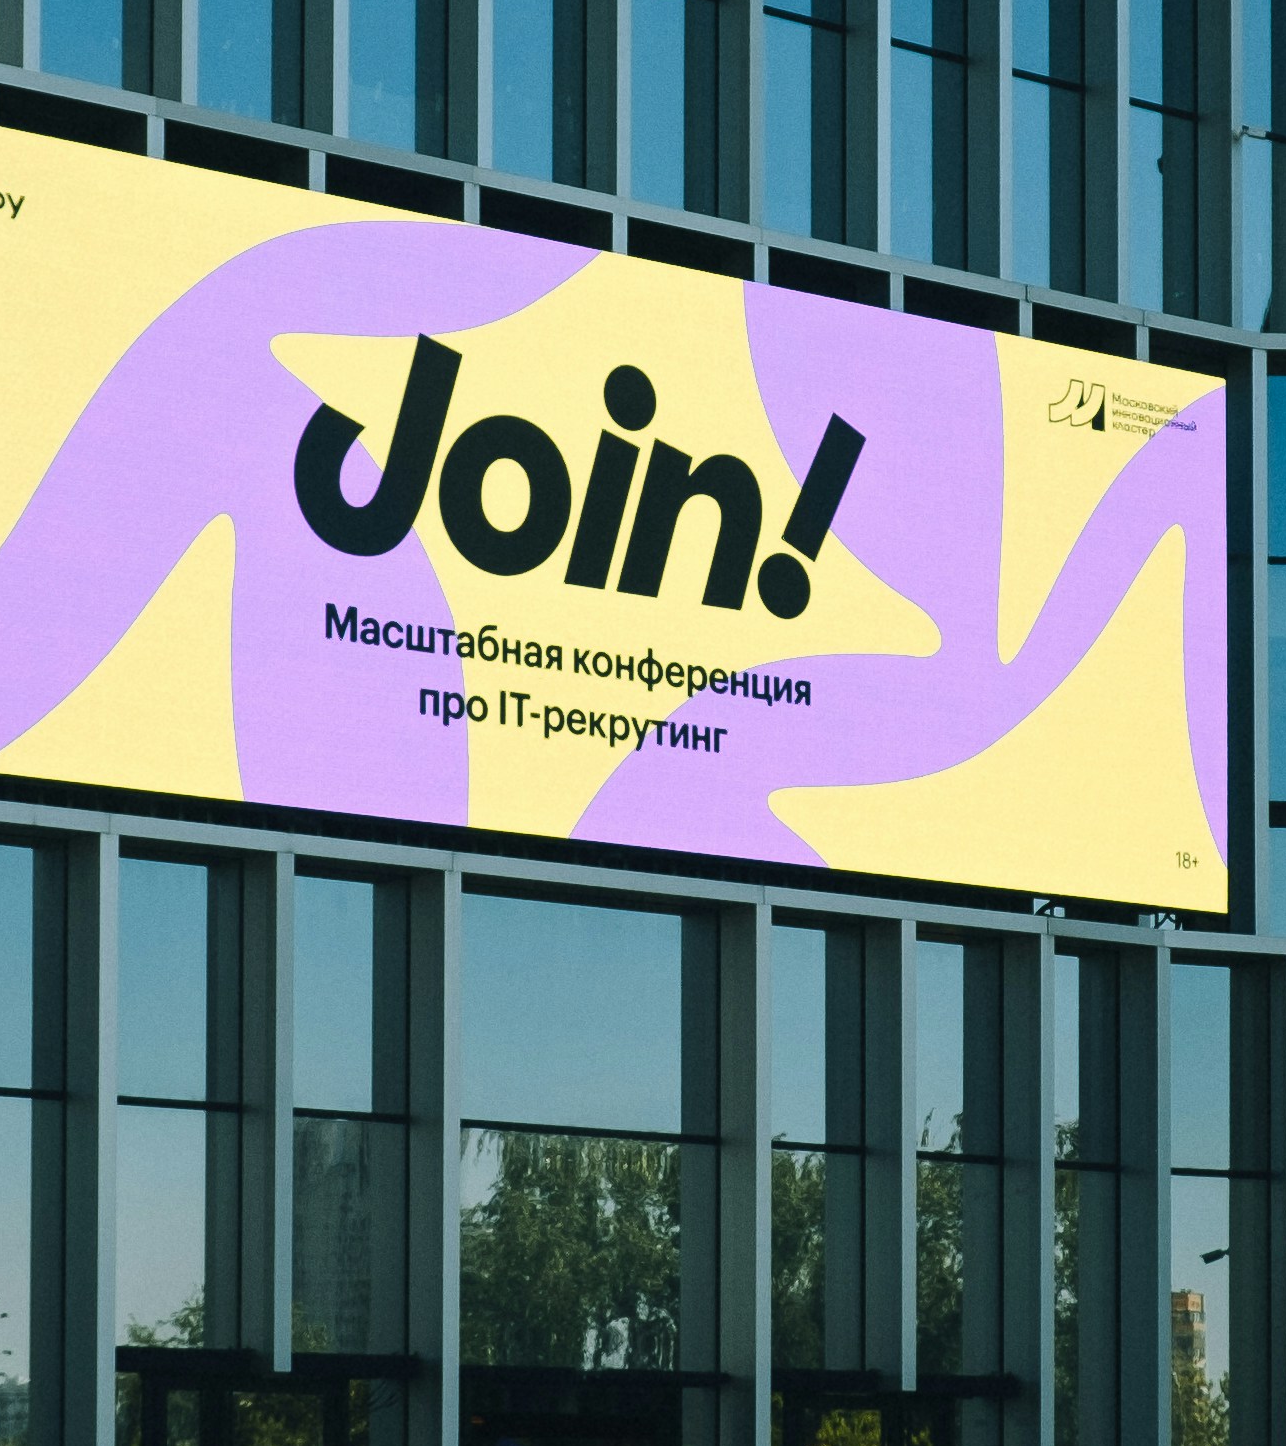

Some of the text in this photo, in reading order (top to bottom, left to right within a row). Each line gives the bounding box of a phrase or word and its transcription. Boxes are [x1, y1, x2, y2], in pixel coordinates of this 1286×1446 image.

[1112, 392, 1179, 415] Московский
[1112, 421, 1156, 440] кластер
[294, 333, 867, 620] Join!
[325, 603, 812, 707] Масштабная конференция
[419, 687, 728, 753] про IT-рекрутинг
[1175, 851, 1200, 870] 18+
